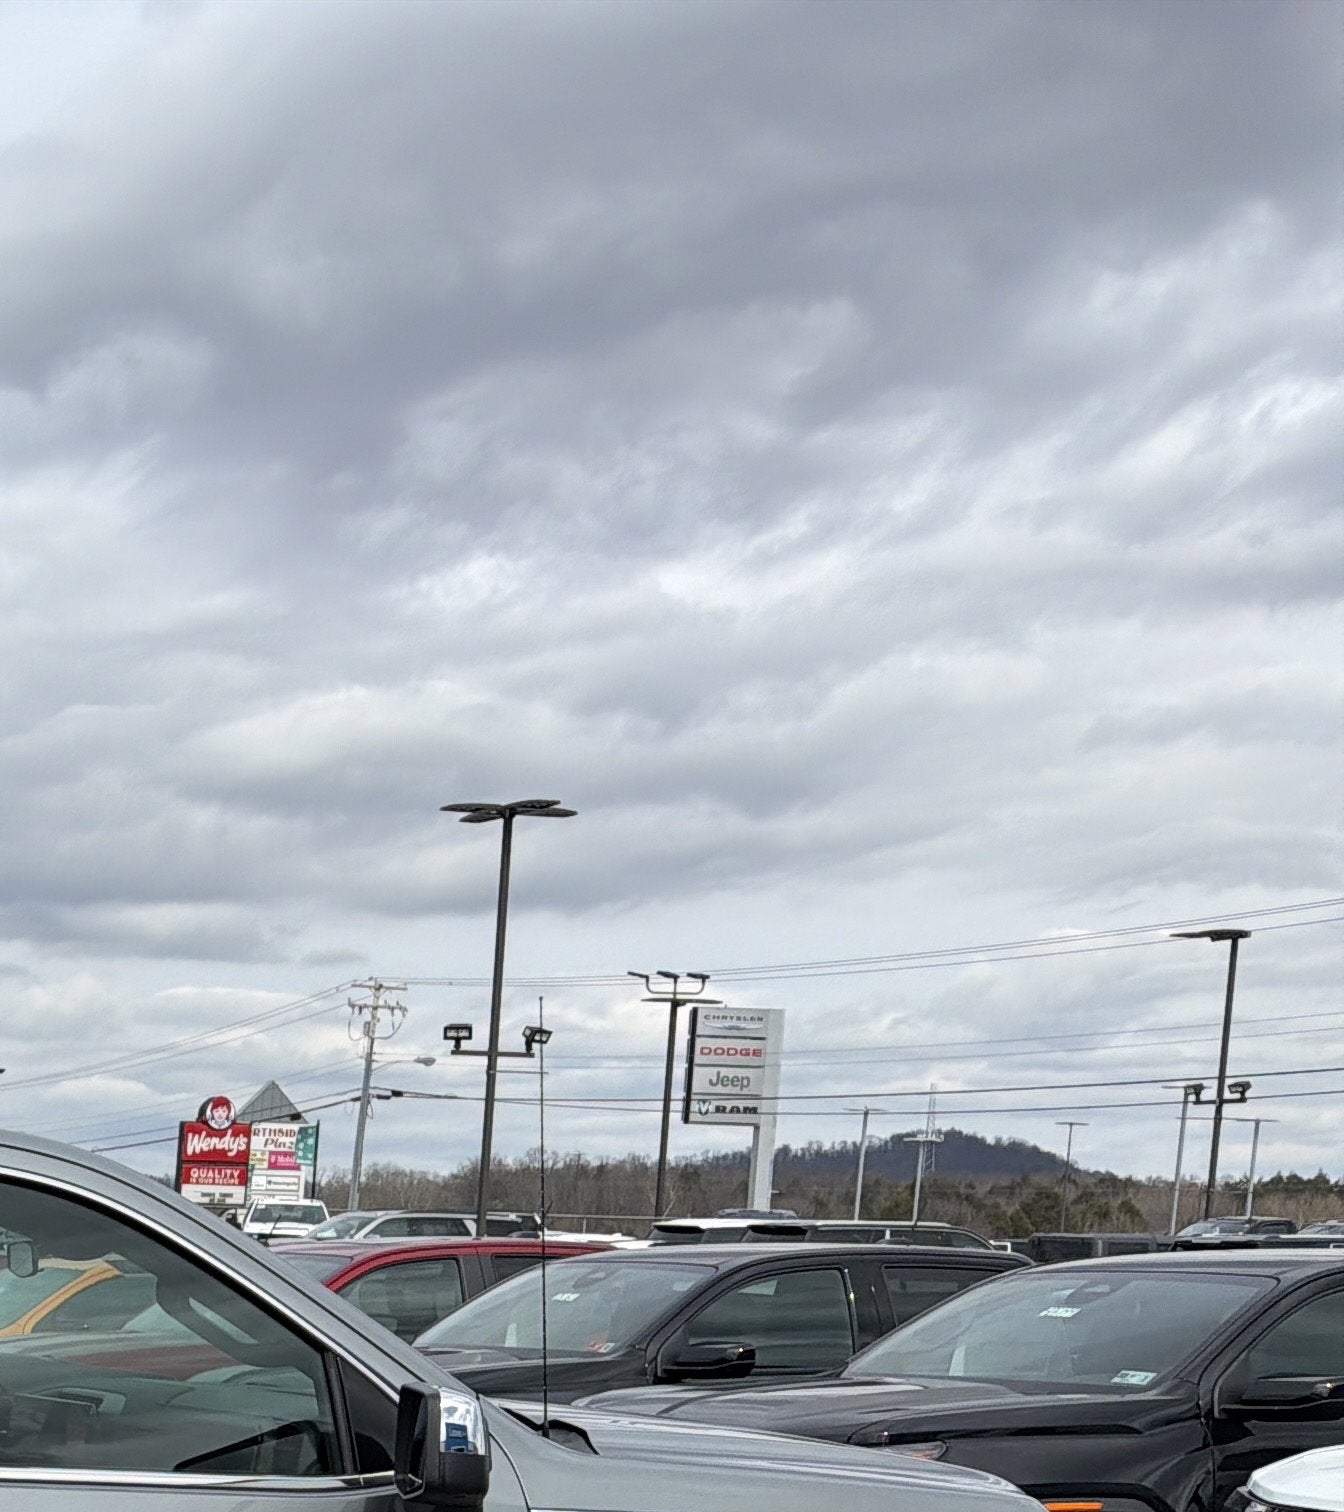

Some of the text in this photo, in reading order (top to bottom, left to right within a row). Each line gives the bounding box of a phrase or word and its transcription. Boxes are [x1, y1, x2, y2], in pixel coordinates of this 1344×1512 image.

[703, 1014, 764, 1022] CHRYSLER
[700, 1046, 763, 1057] DODGE
[709, 1070, 751, 1091] Jeep
[714, 1105, 759, 1115] RAM
[187, 1129, 248, 1157] Wendy's
[264, 1137, 294, 1149] Plaz
[190, 1167, 240, 1179] QUALITY
